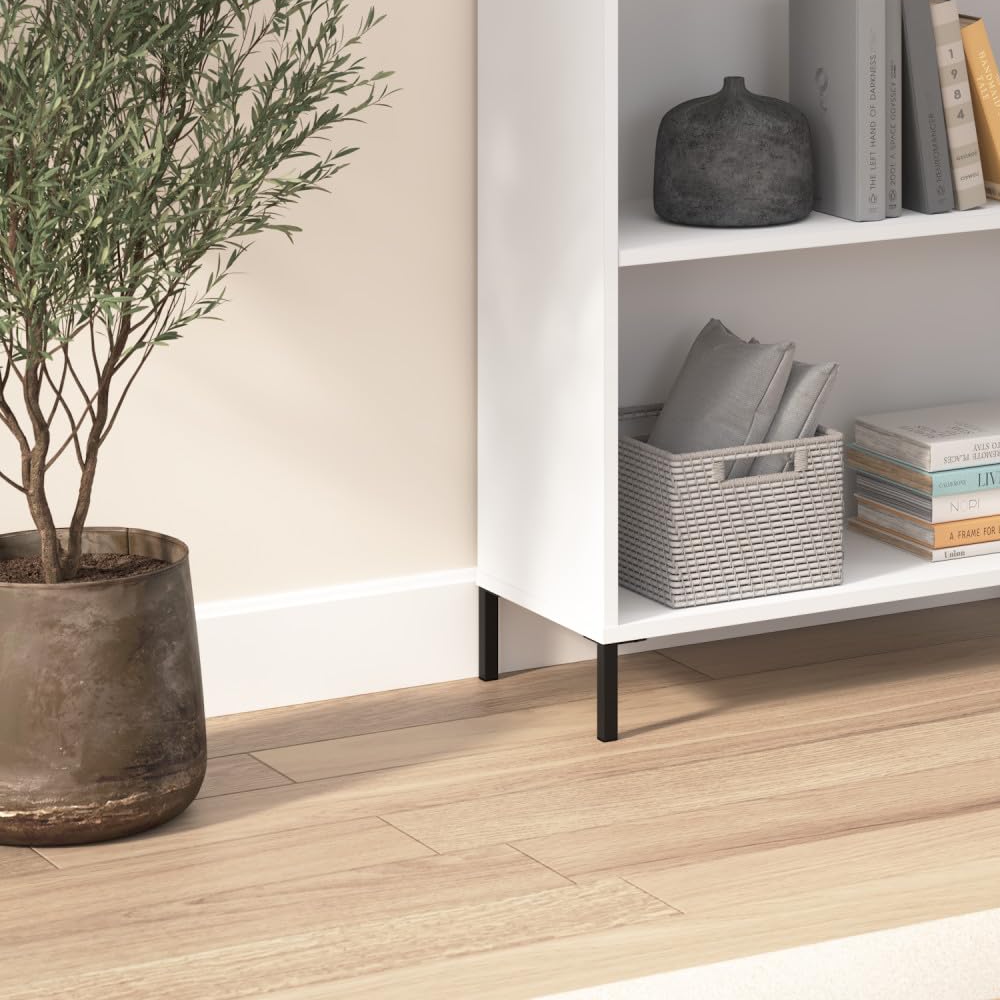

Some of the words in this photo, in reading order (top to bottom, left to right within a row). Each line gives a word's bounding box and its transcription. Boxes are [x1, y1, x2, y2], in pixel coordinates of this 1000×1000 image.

[869, 54, 877, 101] DARKNESS
[869, 103, 877, 118] OF
[869, 120, 877, 148] HAND
[869, 151, 877, 170] LEFT
[869, 175, 877, 190] THE
[949, 531, 954, 541] A
[957, 527, 980, 539] FRAME
[983, 526, 996, 536] FOR
